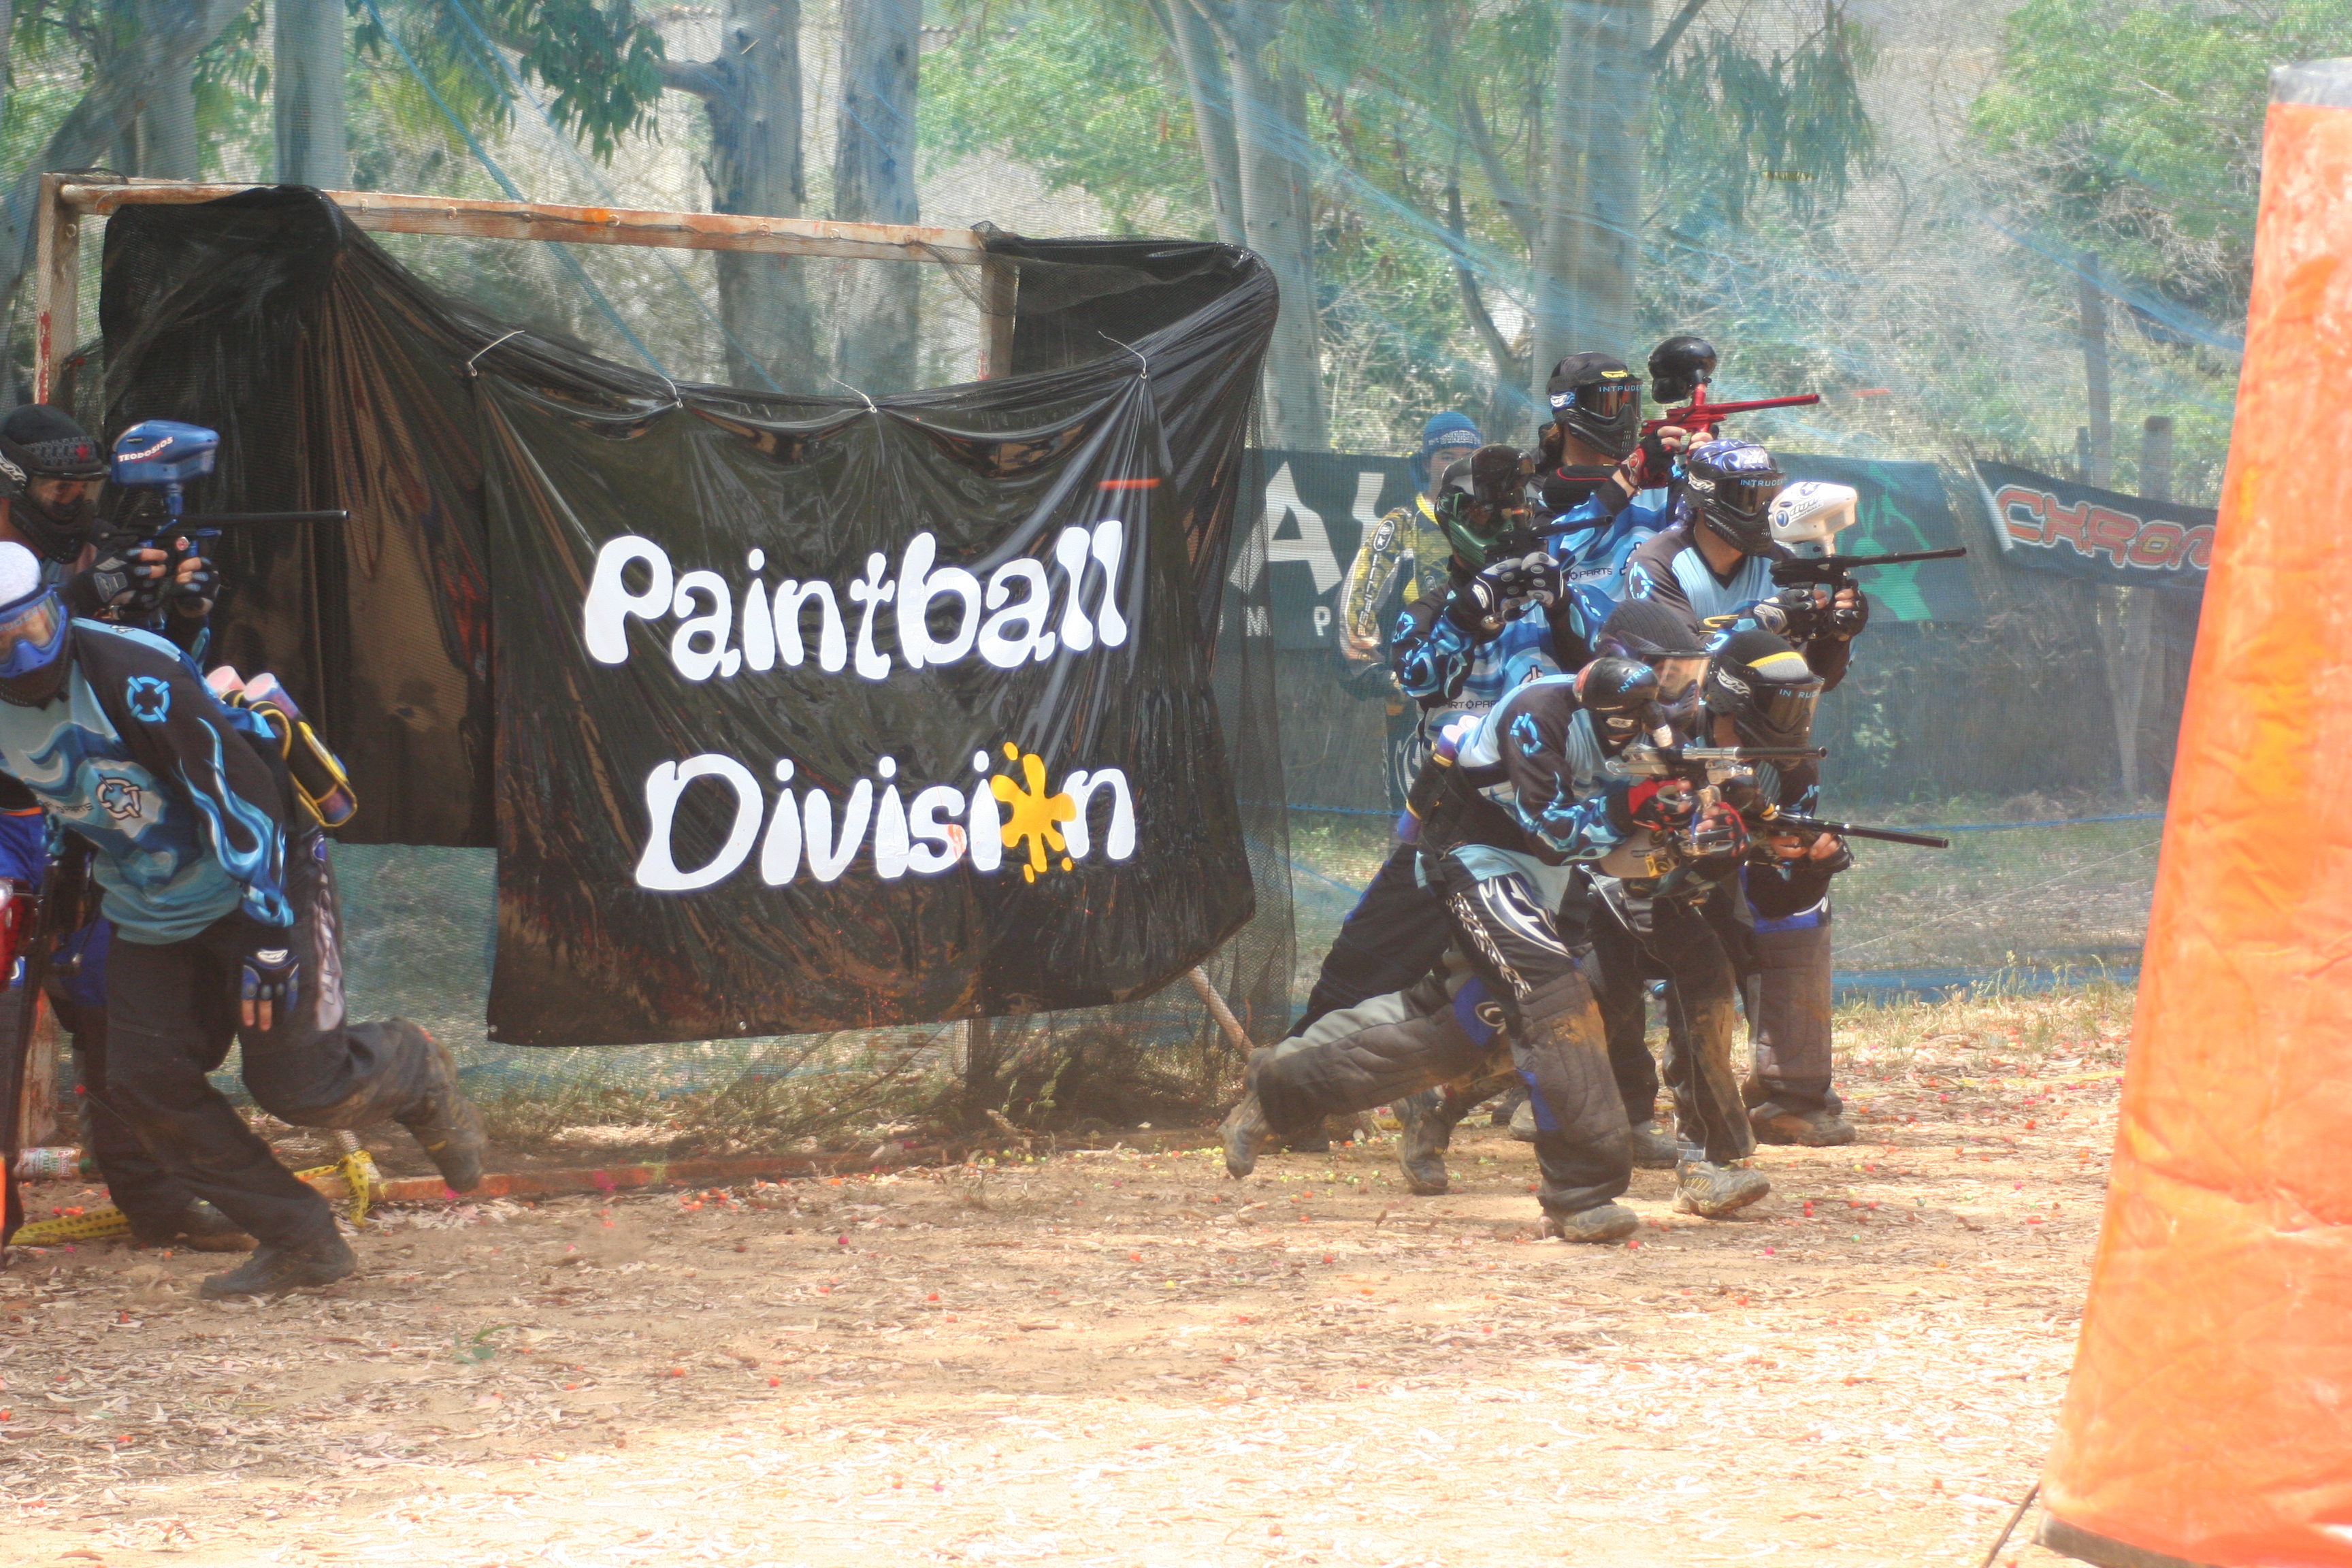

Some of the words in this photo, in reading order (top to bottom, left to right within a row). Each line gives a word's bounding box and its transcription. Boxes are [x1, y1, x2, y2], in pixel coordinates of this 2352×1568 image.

[118, 436, 174, 462] TEODOSIOS
[1580, 568, 1612, 578] PARTS
[585, 520, 1128, 681] Paintball
